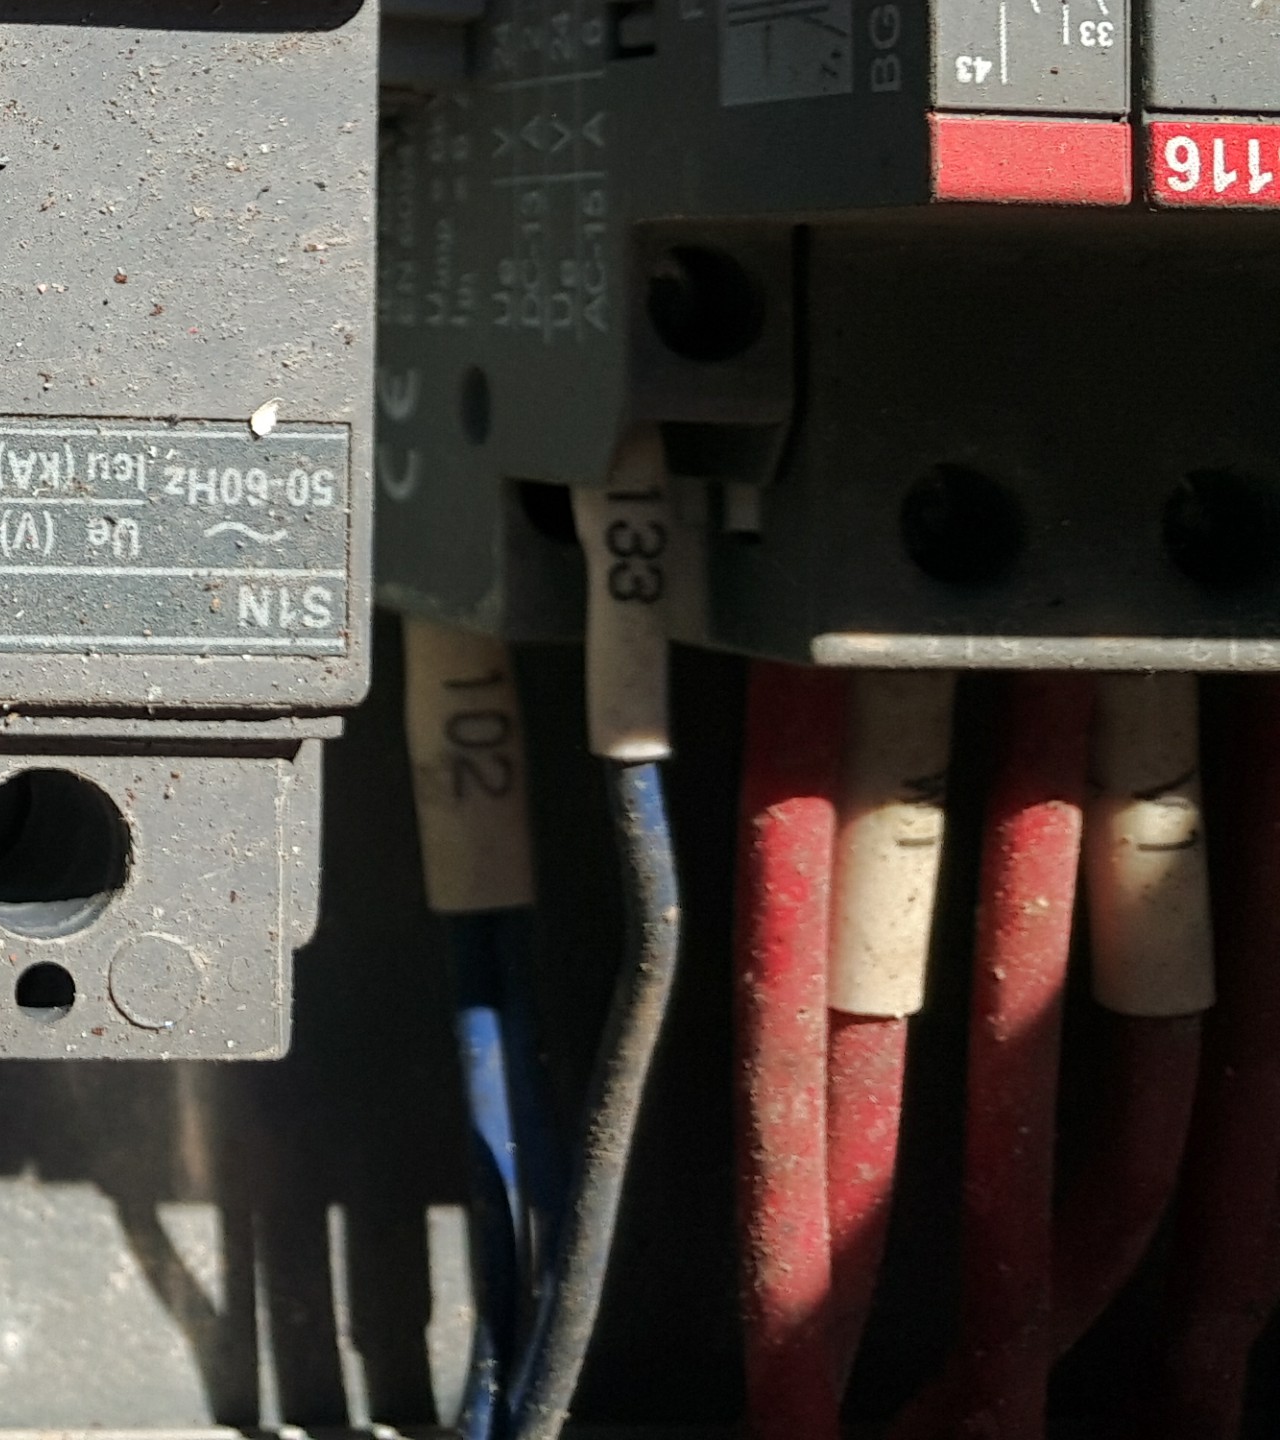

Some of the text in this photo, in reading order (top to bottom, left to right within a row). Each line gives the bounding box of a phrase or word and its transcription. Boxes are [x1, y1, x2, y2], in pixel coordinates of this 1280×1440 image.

[868, 4, 902, 93] BG
[1079, 21, 1114, 47] 33
[955, 56, 992, 84] 43
[1164, 135, 1280, 193] 116
[87, 452, 146, 492] Icu
[164, 466, 336, 507] 50-60Hz
[0, 510, 141, 558] Ue (V)
[606, 489, 667, 604] 133
[238, 585, 332, 630] S1N
[443, 673, 513, 802] 102
